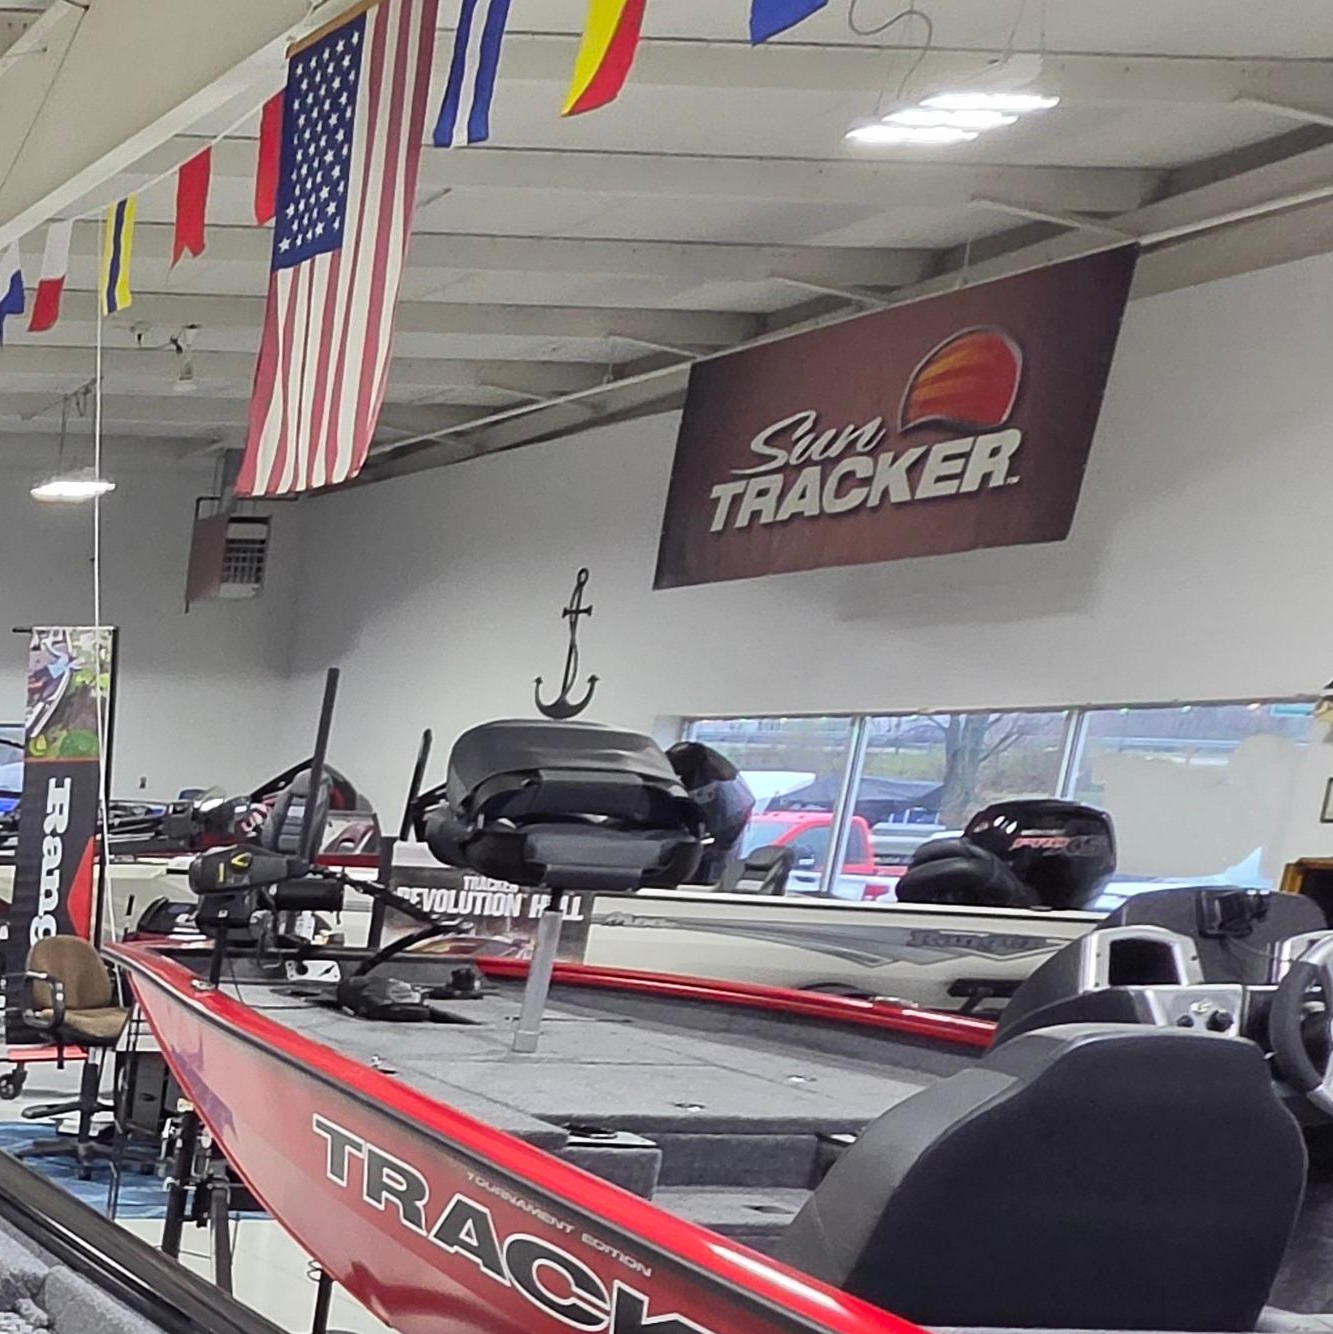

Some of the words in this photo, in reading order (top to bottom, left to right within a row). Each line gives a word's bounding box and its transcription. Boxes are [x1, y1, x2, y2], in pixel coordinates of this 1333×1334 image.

[709, 428, 1022, 533] TRACKER
[731, 410, 887, 474] Sun
[30, 777, 72, 947] Rang
[463, 876, 519, 893] TRACKER
[529, 894, 584, 921] HLL
[467, 1171, 576, 1233] TOURNAMENT
[582, 1232, 652, 1277] EDITION
